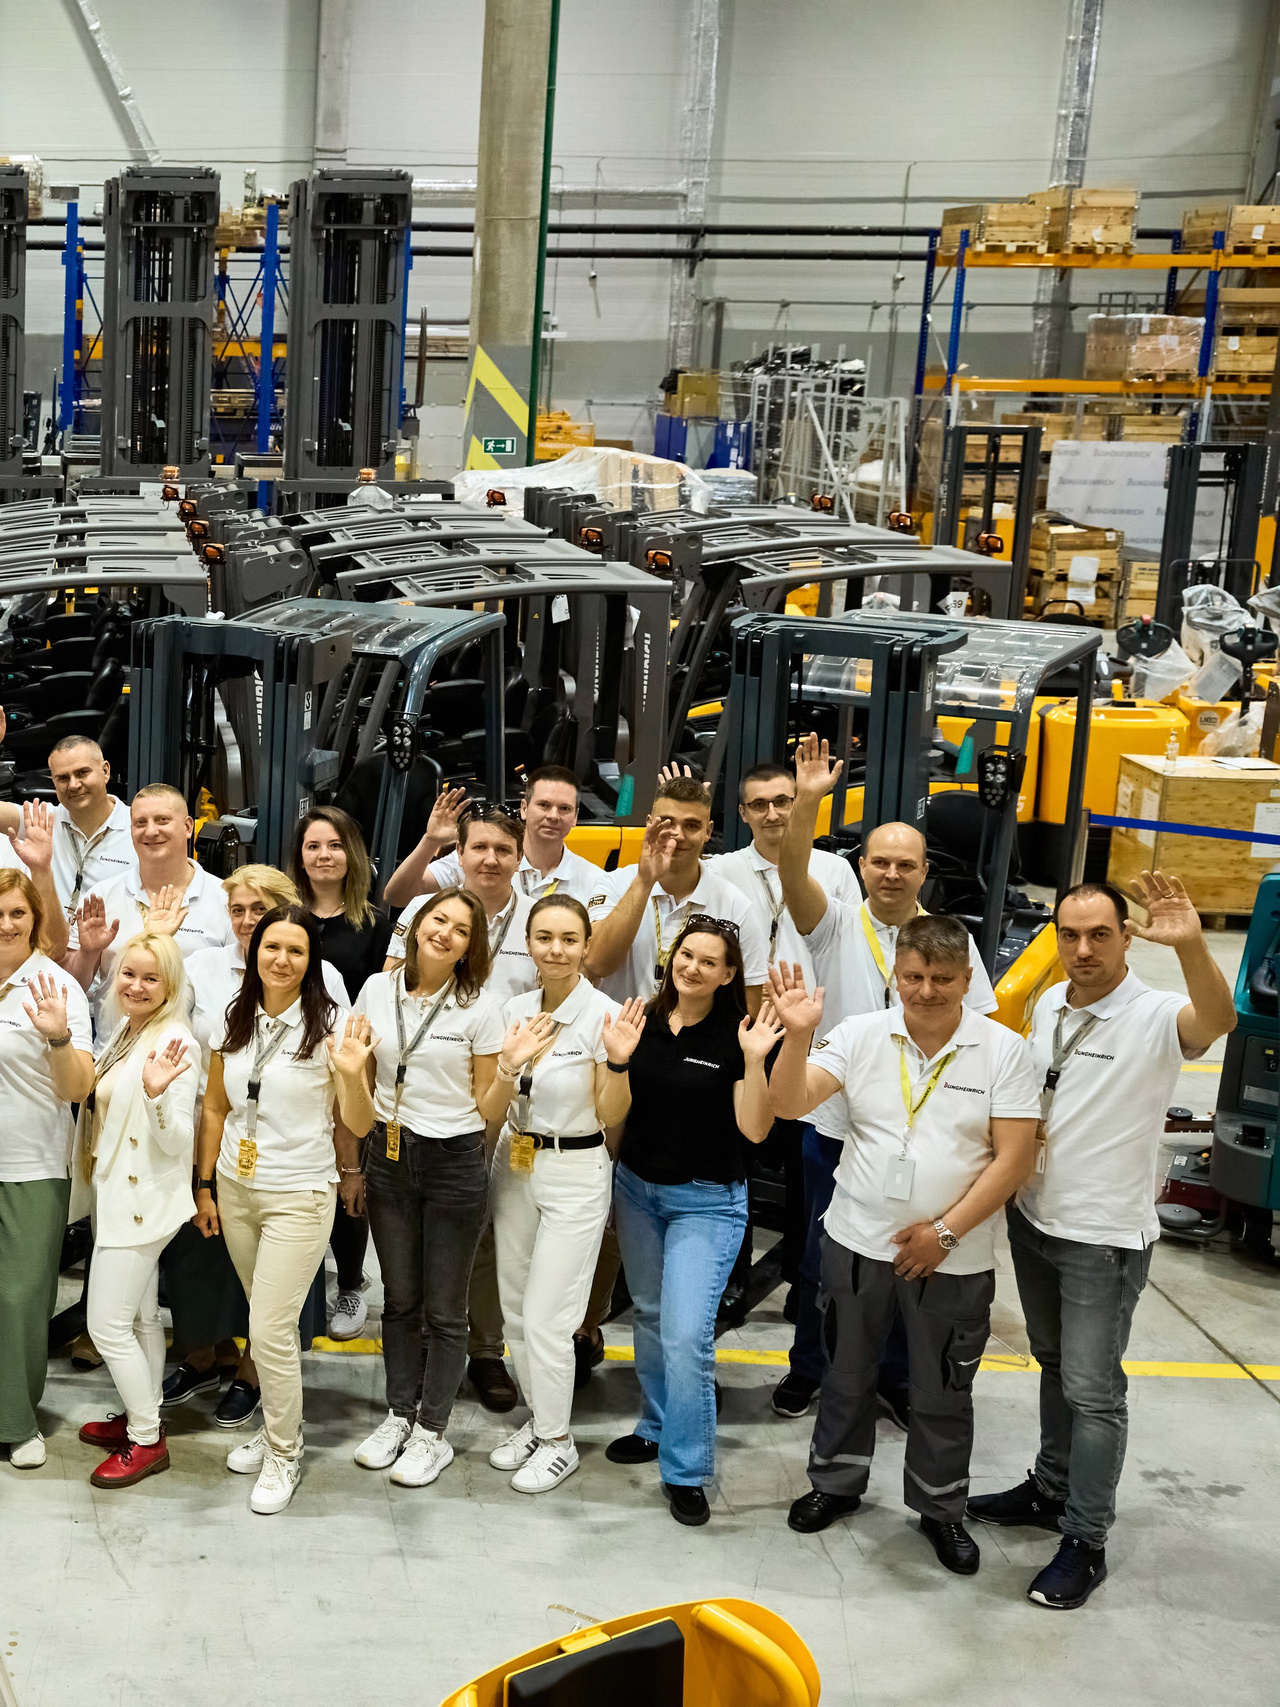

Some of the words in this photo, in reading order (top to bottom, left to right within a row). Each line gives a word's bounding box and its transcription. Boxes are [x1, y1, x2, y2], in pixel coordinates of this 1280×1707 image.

[1074, 1048, 1115, 1061] JUNGHEINRICH
[683, 1057, 720, 1069] JUNGHEINRICH
[944, 1081, 985, 1095] JUNGHEINRICH
